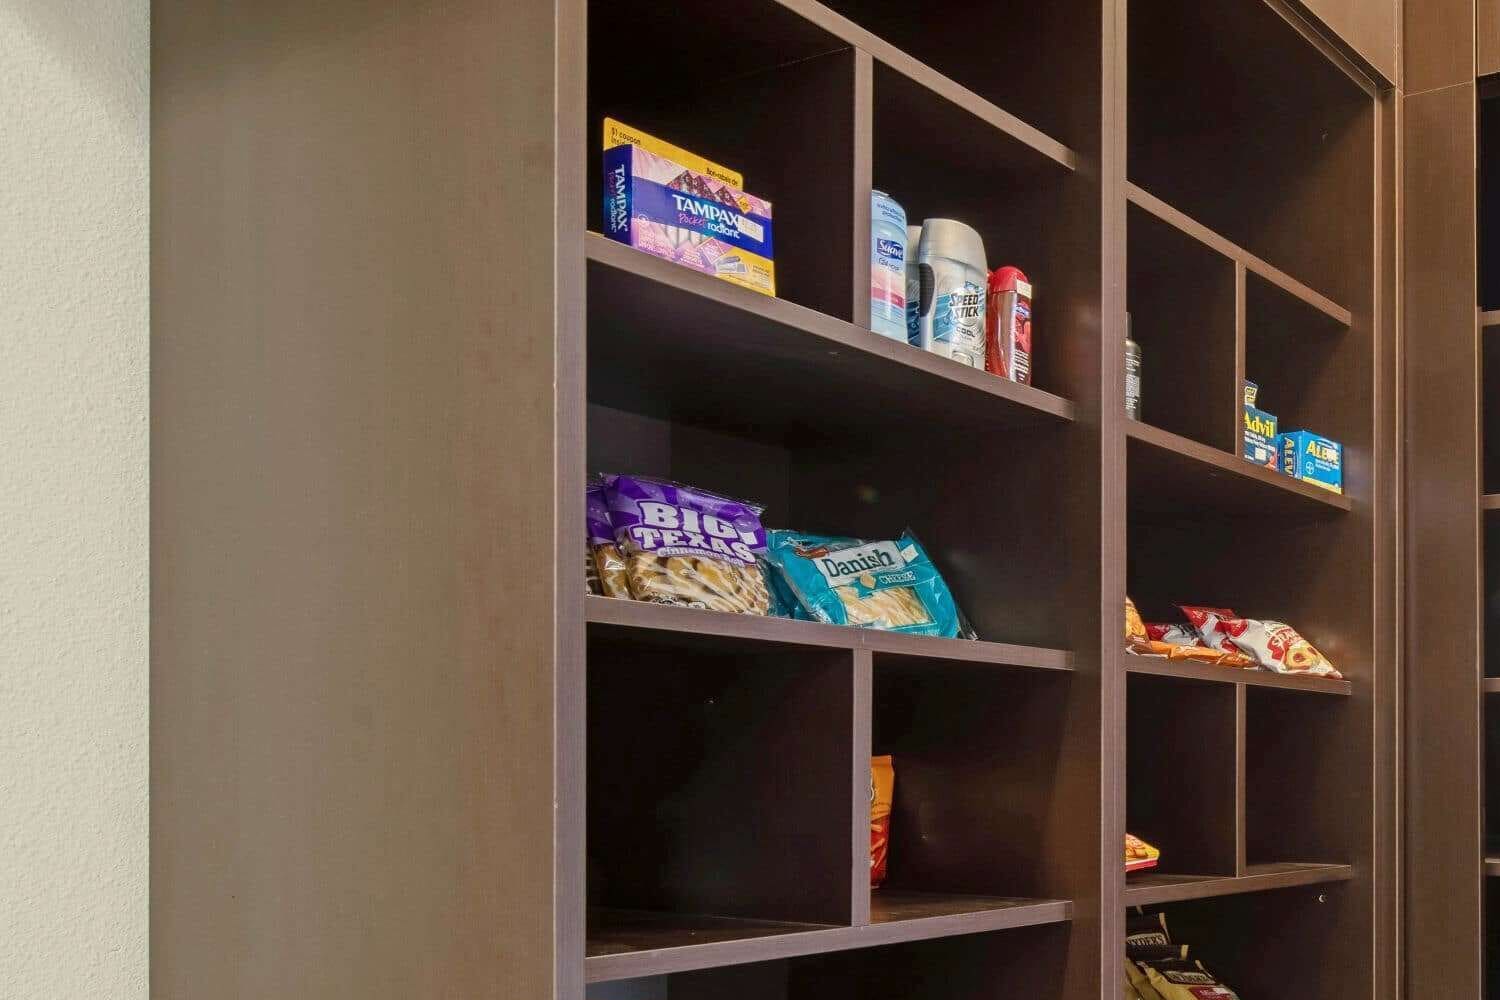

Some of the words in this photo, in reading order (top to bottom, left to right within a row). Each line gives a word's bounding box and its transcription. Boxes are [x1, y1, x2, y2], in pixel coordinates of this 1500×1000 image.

[615, 164, 628, 231] TAMPAX
[672, 195, 739, 229] TAMPAX
[707, 222, 740, 239] radiant
[951, 293, 978, 306] SPEED
[955, 306, 979, 319] STICK
[1285, 437, 1294, 477] ALEV
[633, 527, 757, 565] TEXAS
[821, 549, 896, 580] Danish
